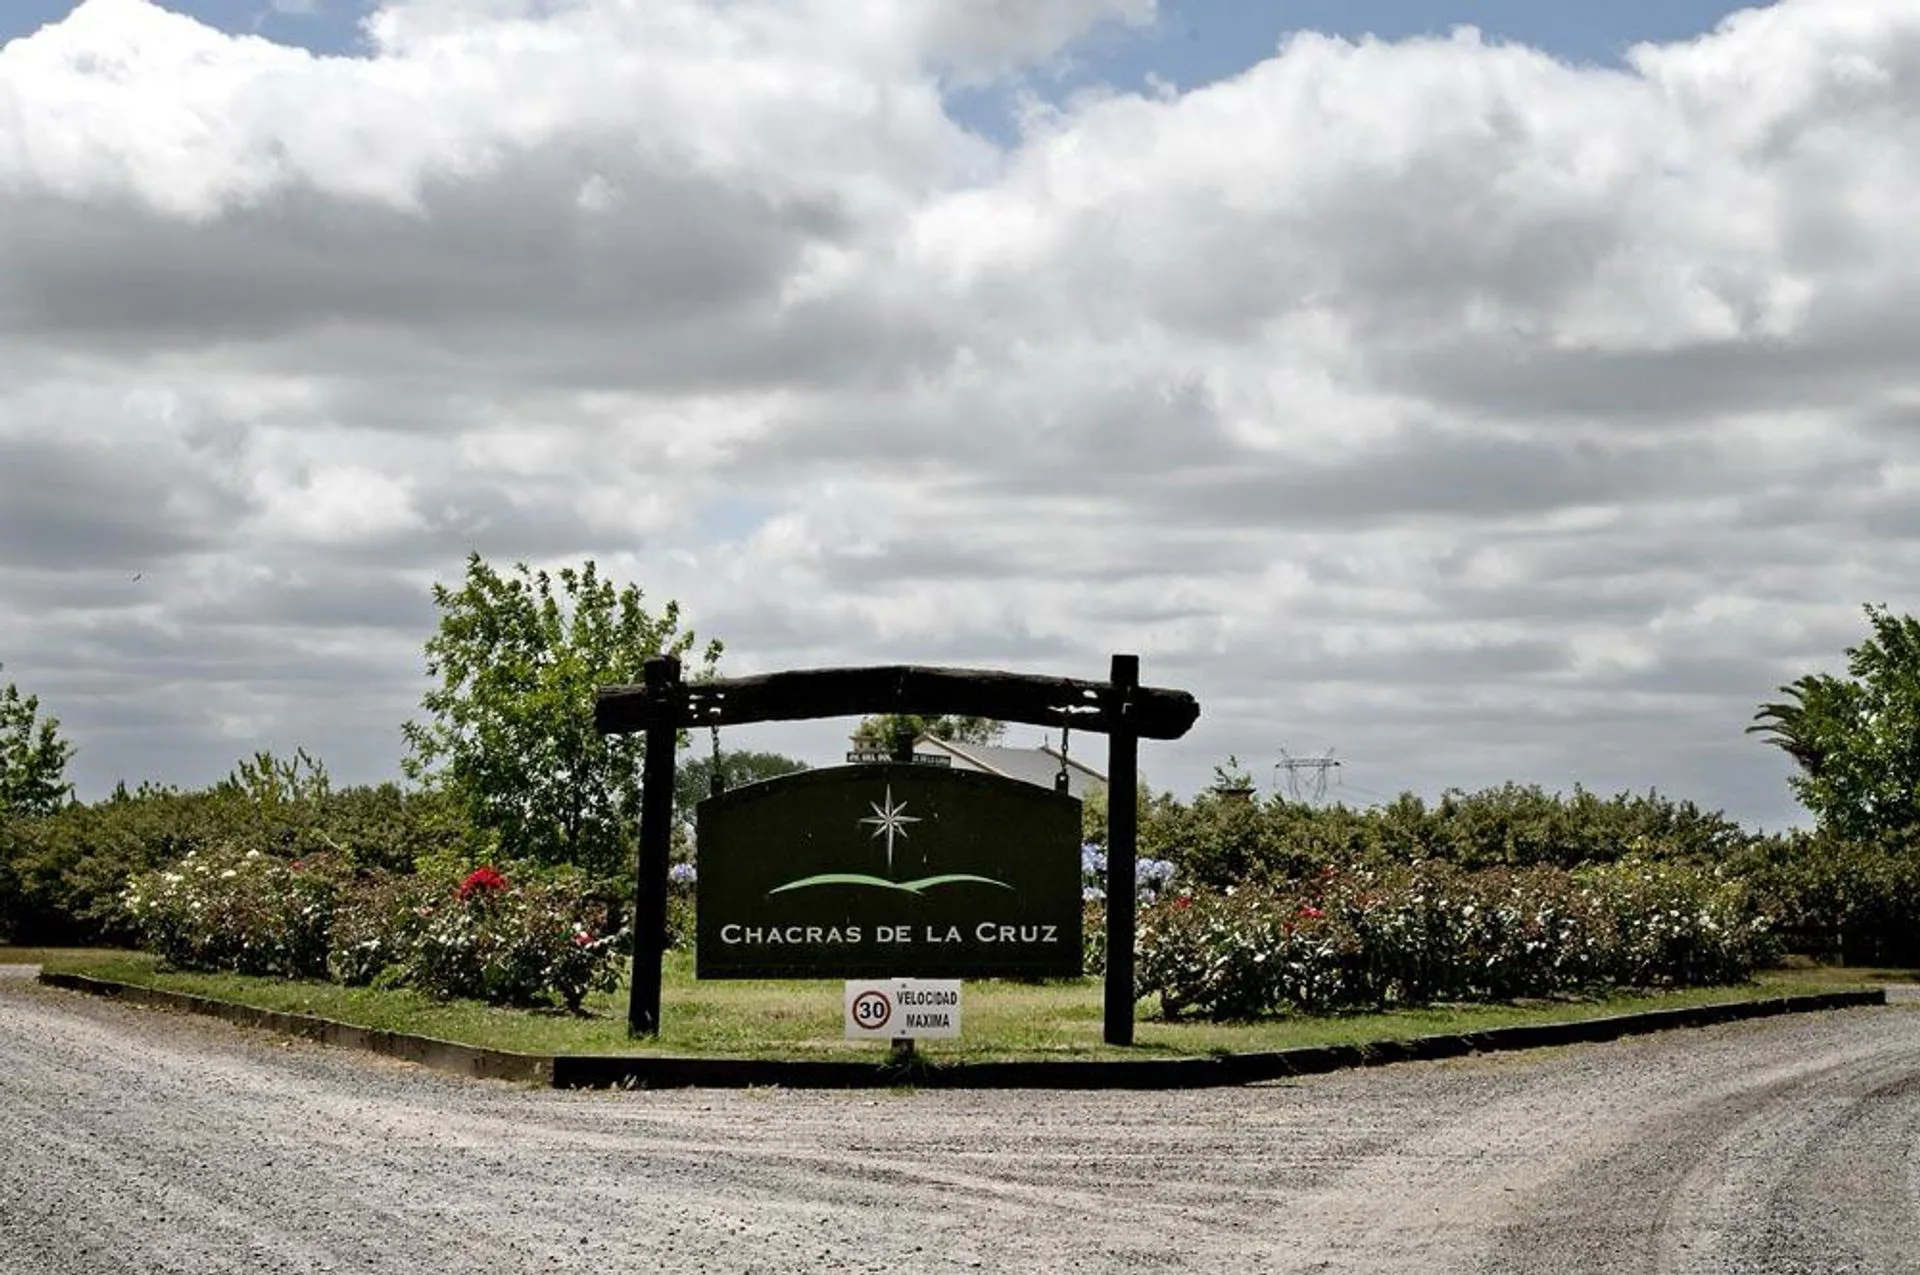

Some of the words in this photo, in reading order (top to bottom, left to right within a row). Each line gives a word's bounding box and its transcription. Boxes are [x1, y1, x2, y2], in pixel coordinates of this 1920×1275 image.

[896, 991, 958, 1006] VELOCIDAD
[859, 1001, 885, 1019] 30
[906, 1014, 951, 1028] MAXIMA
